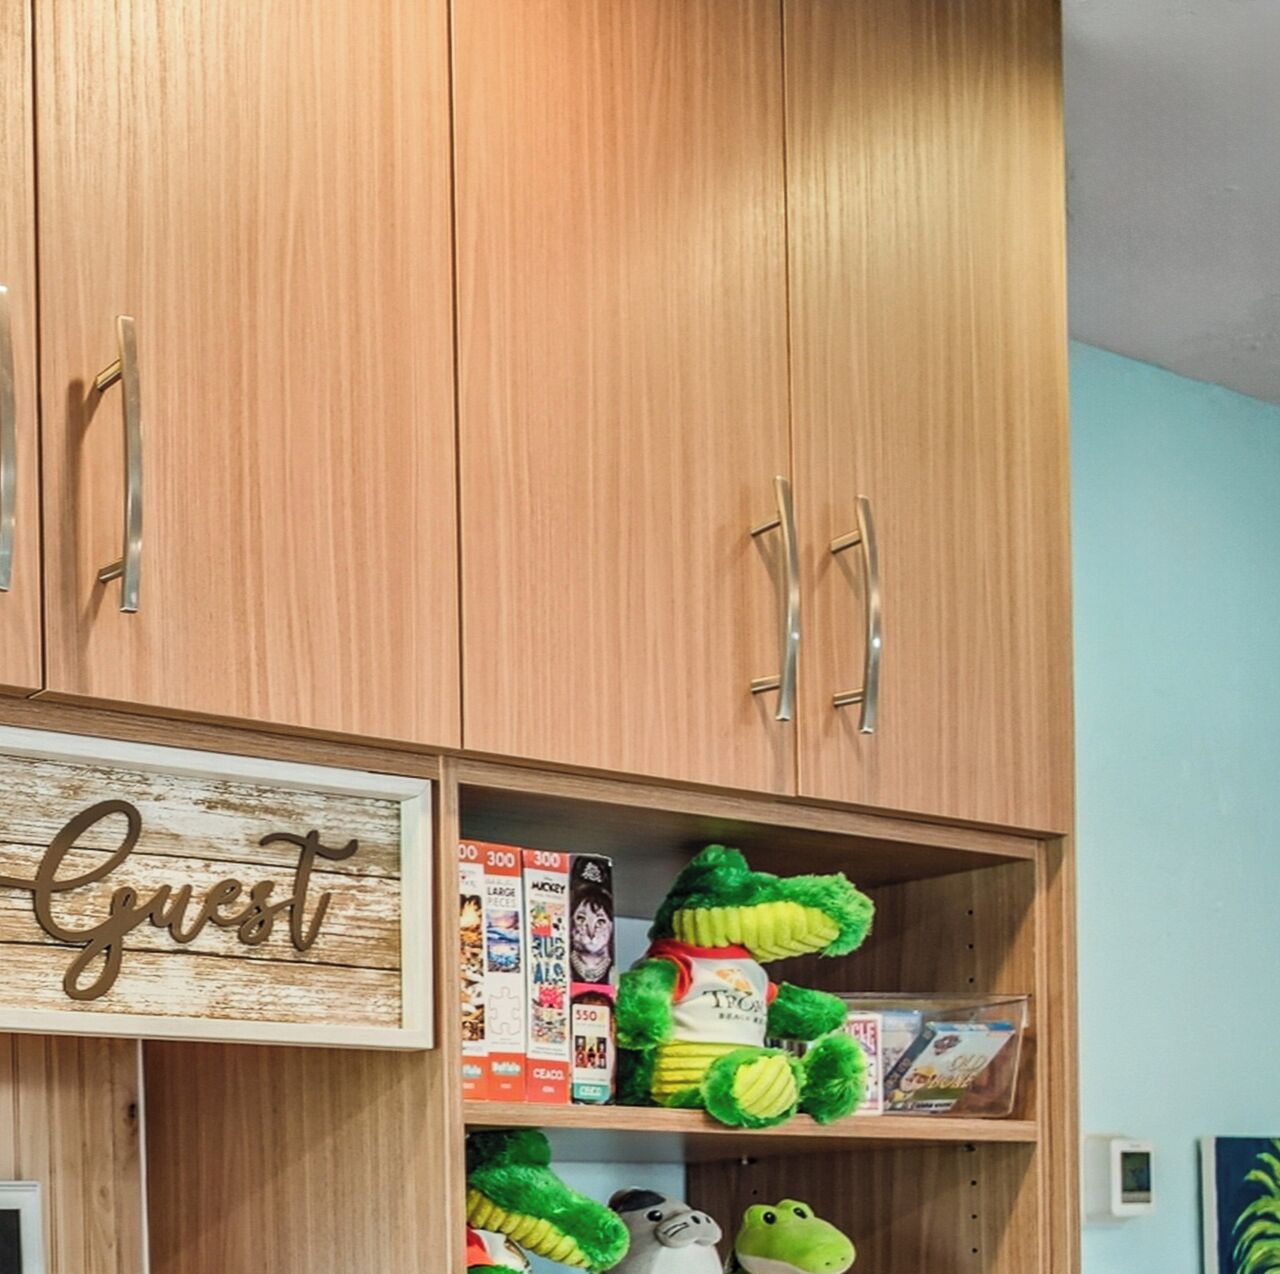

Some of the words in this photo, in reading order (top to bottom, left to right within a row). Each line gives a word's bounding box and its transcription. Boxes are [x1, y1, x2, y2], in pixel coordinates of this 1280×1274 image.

[486, 850, 515, 868] 300
[534, 850, 561, 868] 300
[487, 886, 516, 898] LARGE
[575, 1009, 598, 1022] 550
